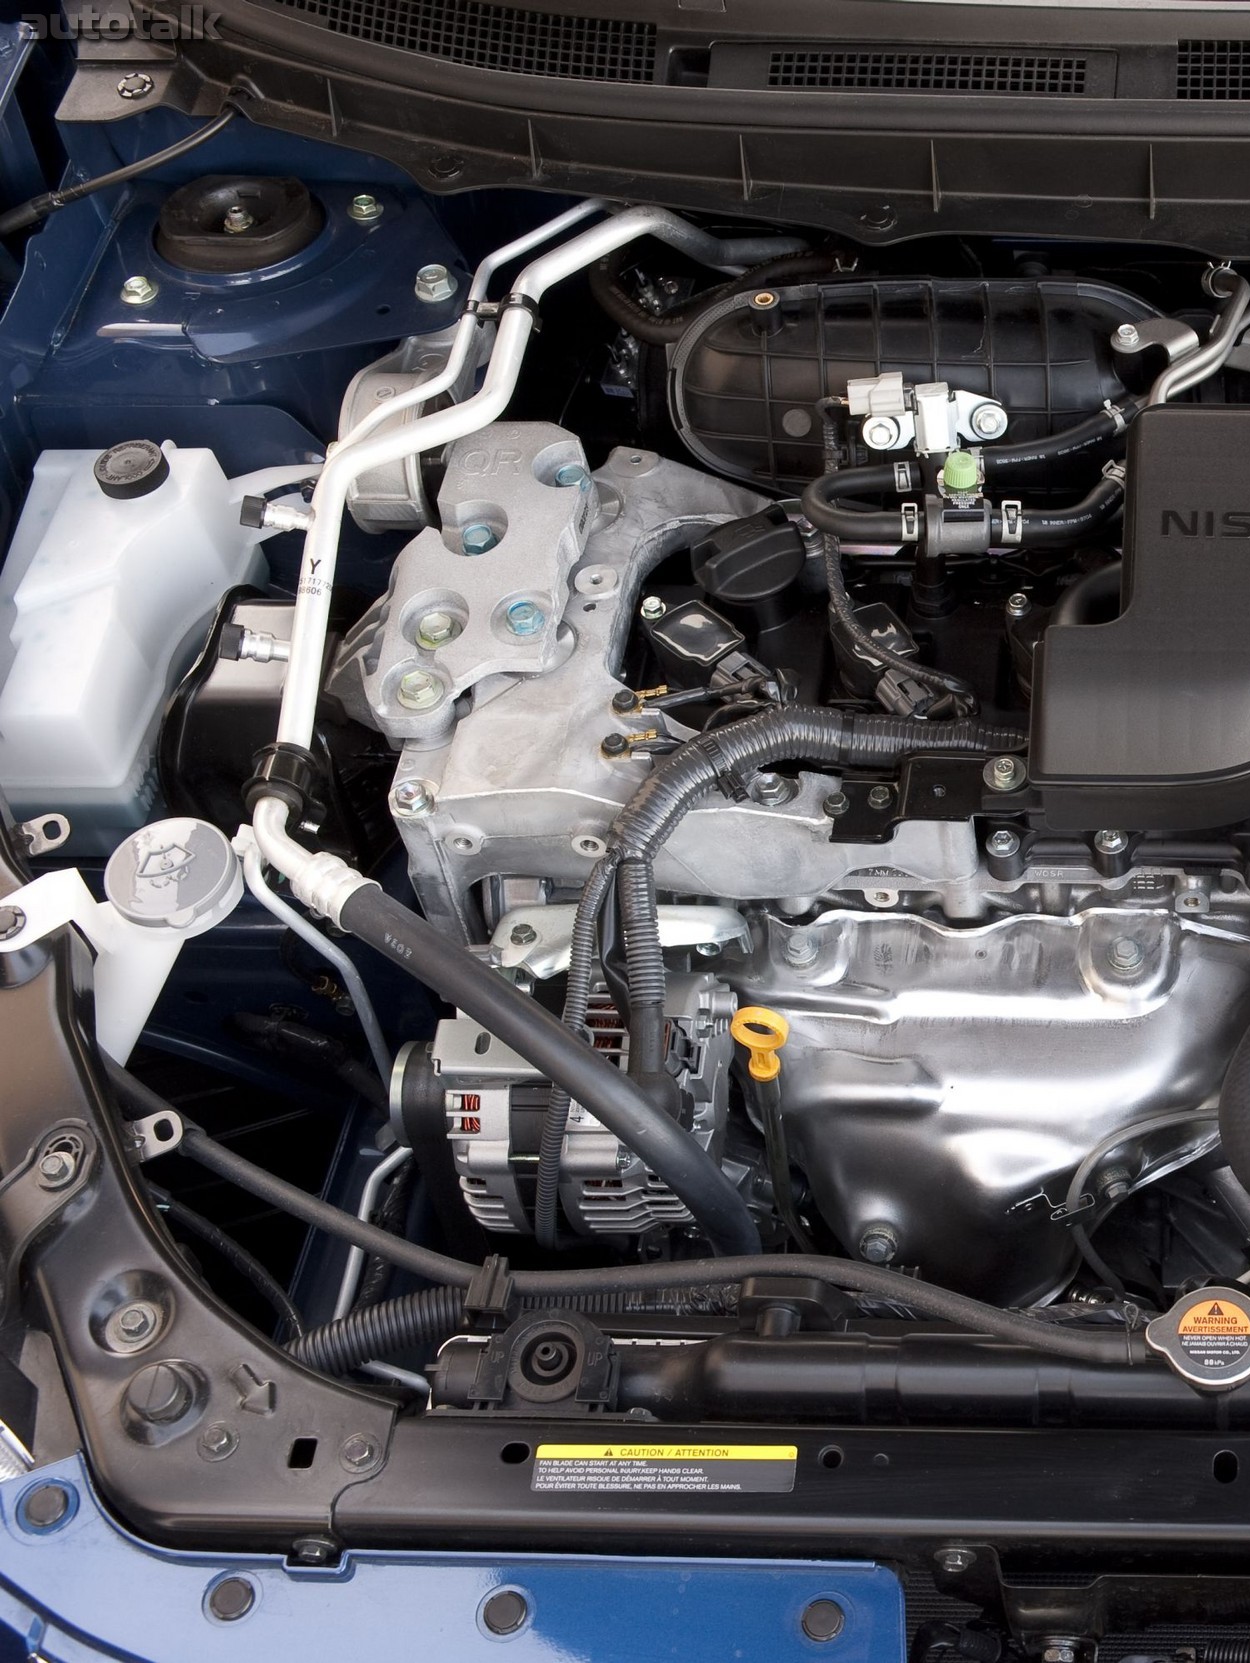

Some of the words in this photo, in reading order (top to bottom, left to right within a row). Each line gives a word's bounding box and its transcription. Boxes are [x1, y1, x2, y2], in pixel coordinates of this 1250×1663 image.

[460, 449, 523, 478] QR
[309, 558, 322, 575] Y
[1193, 1316, 1238, 1325] WARNING
[586, 1353, 603, 1367] UP
[620, 1448, 664, 1457] CAUTION
[666, 1449, 672, 1457] /
[675, 1449, 729, 1457] ATTENTION
[621, 1474, 656, 1482] DÉMARRER
[656, 1474, 662, 1482] À
[554, 1481, 576, 1489] ÉVITER
